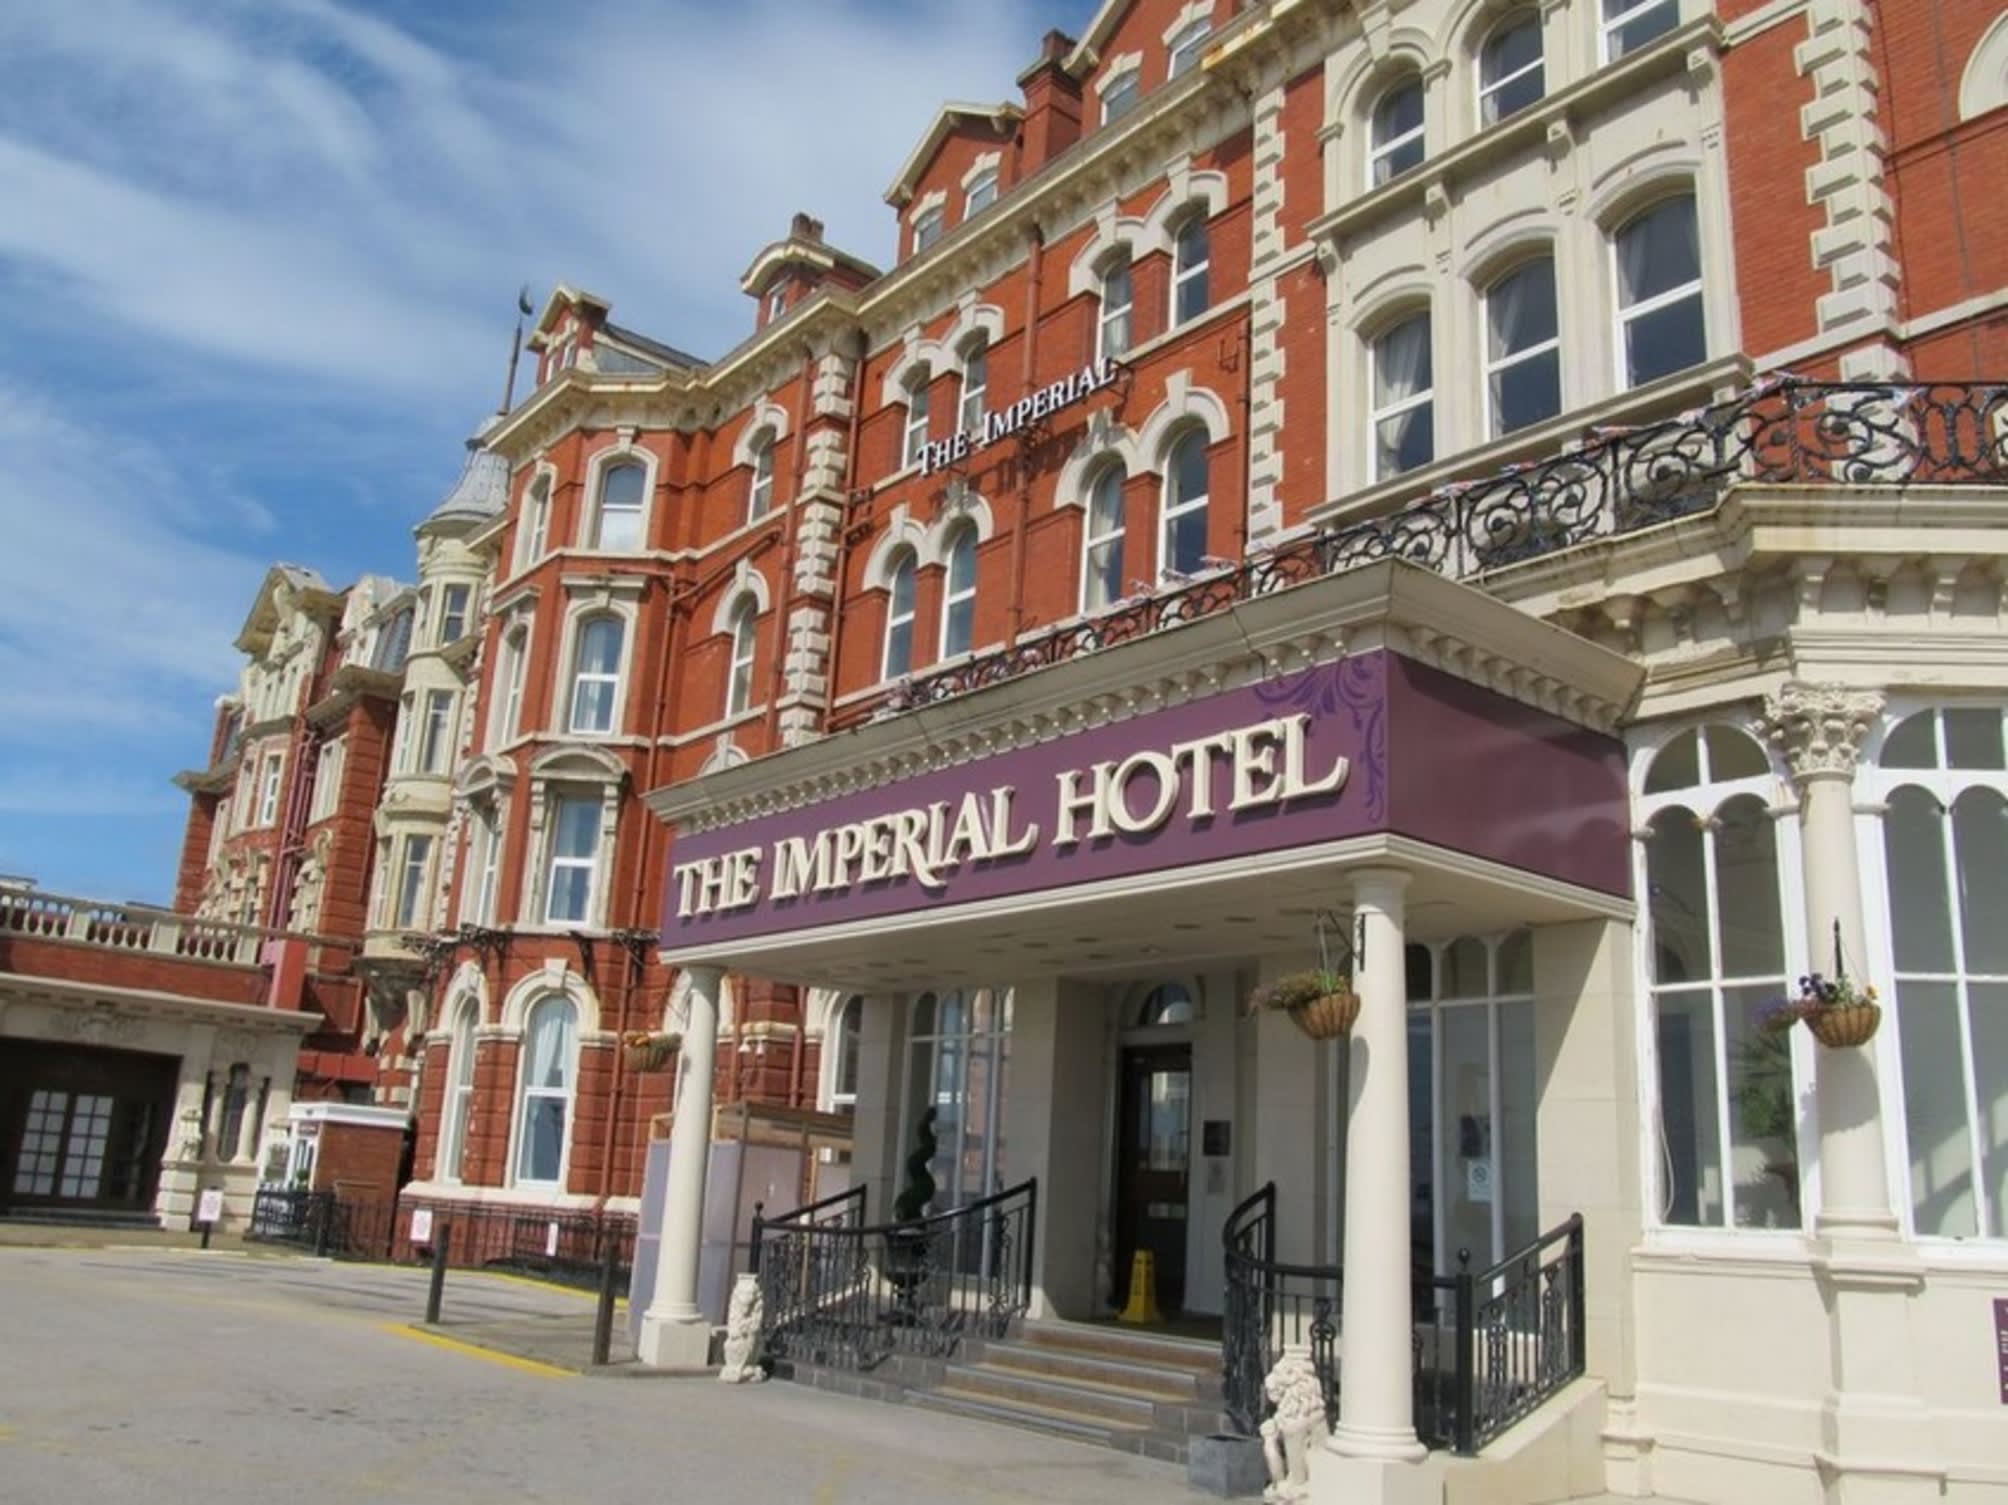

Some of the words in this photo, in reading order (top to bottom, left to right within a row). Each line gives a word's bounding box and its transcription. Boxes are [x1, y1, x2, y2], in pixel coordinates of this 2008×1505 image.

[917, 432, 971, 476] THE
[978, 357, 1117, 447] IMPERIAL
[674, 846, 762, 919] THE
[769, 785, 1039, 900] IMPERIAL
[1053, 713, 1350, 846] HOTEL
